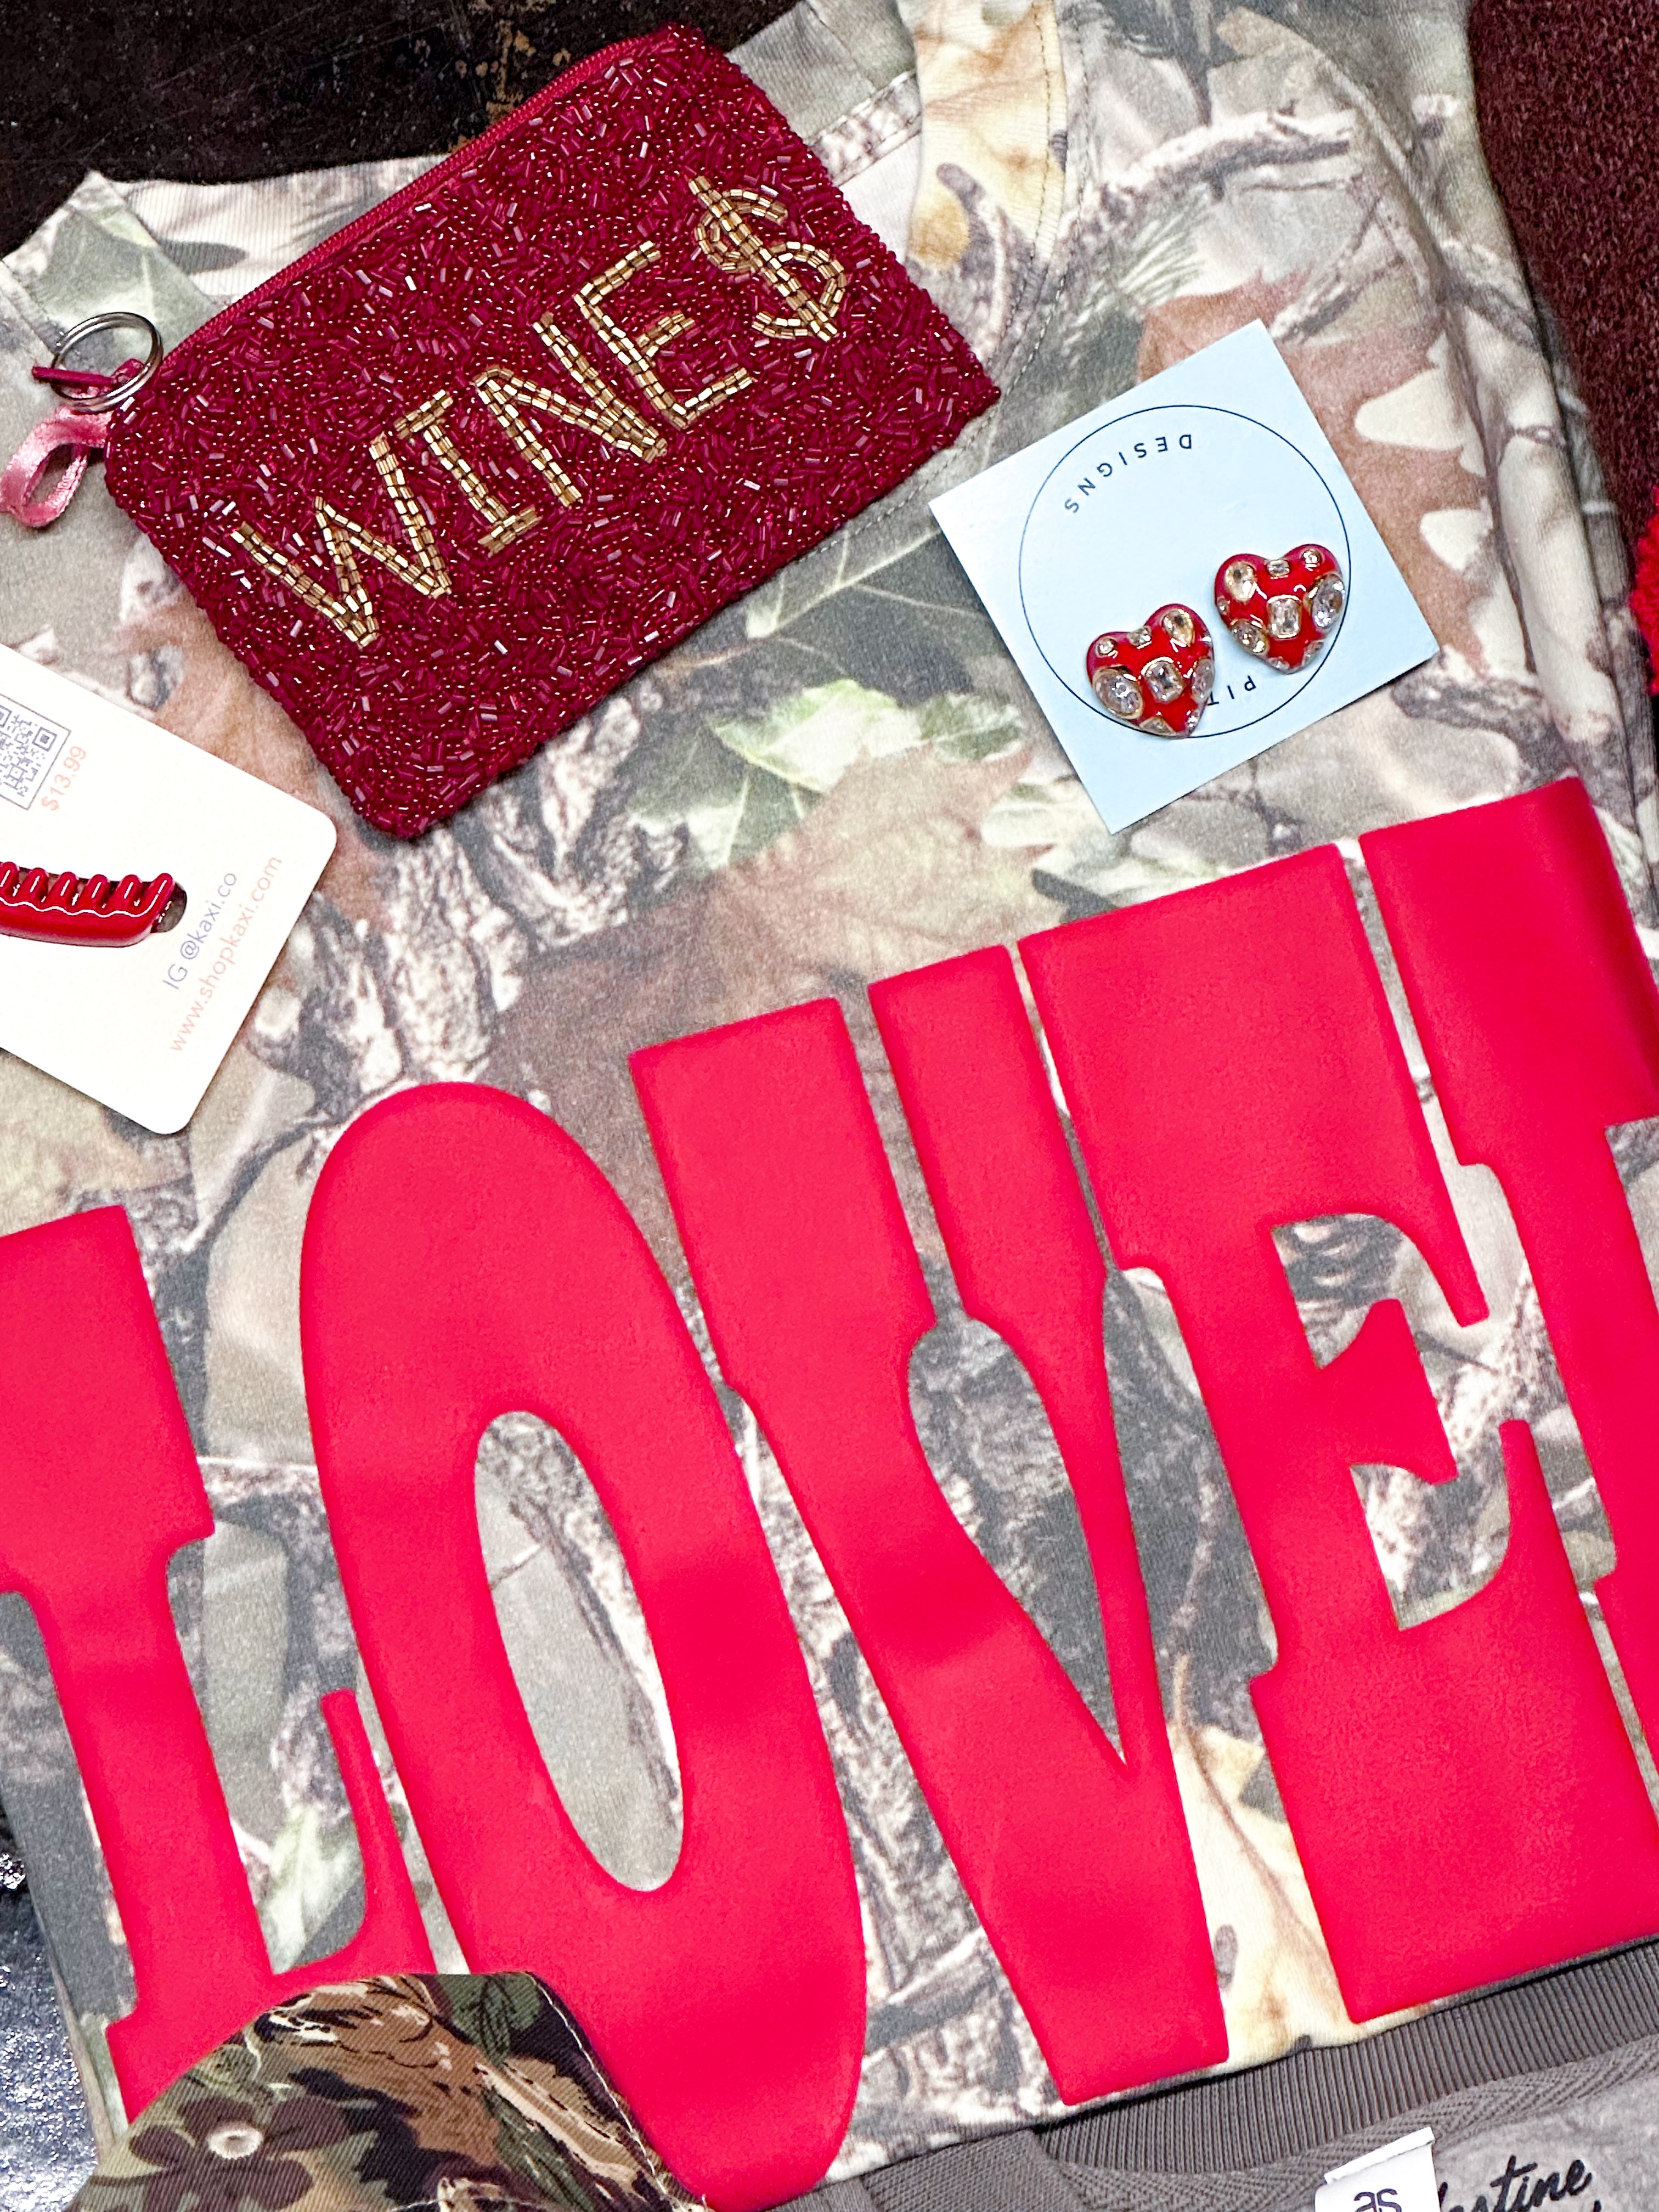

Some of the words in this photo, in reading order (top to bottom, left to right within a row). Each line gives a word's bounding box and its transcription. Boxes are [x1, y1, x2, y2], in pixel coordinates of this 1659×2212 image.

[1064, 433, 1193, 514] DESIGNS
[41, 746, 87, 811] $13.99
[163, 963, 189, 990] IG
[180, 873, 237, 960] @kaxi.co
[169, 857, 283, 1053] www.shopkaxi.com
